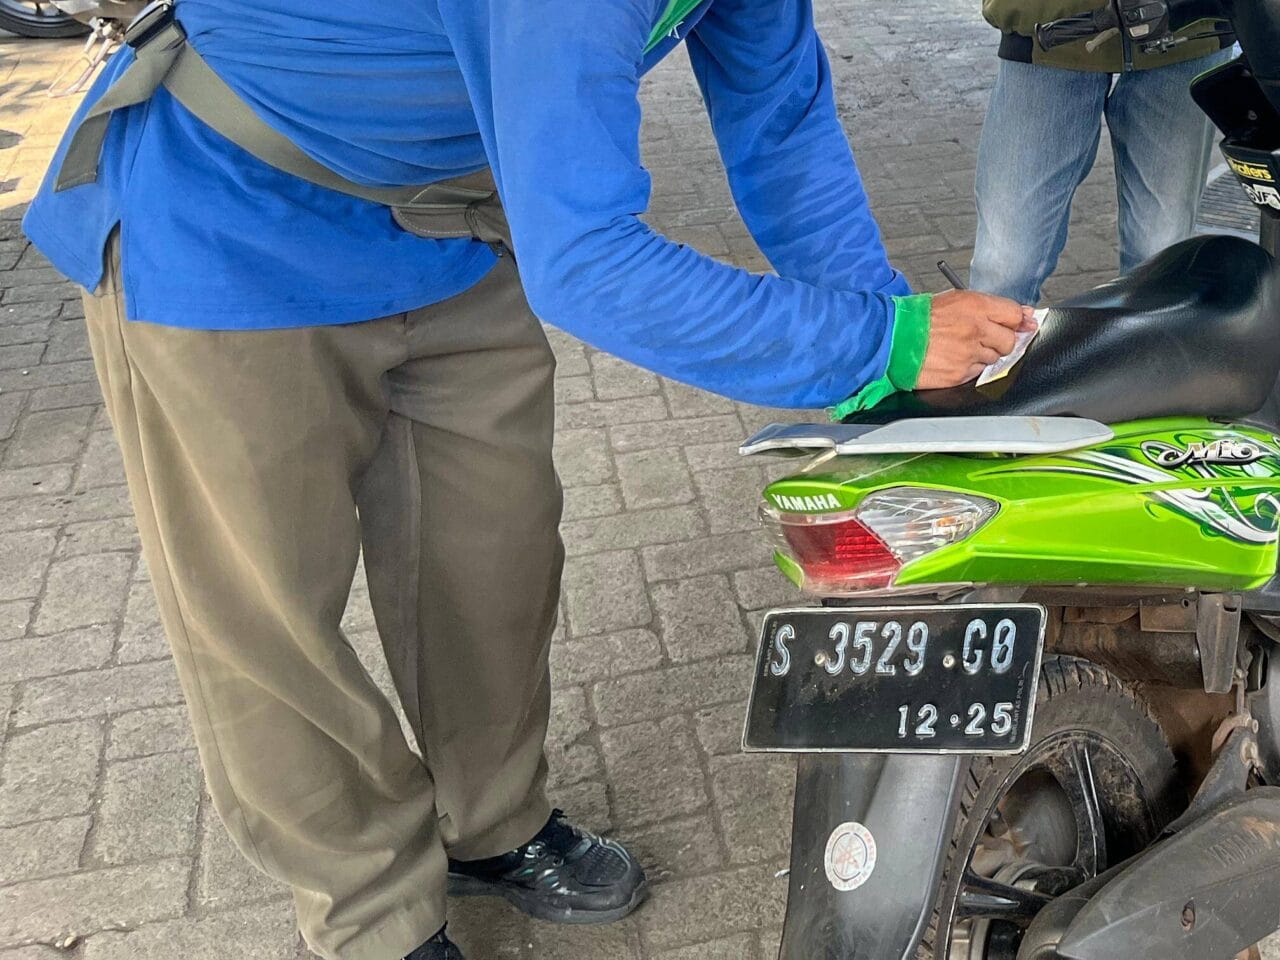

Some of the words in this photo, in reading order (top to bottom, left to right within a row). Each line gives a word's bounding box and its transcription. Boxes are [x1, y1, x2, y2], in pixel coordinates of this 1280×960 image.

[771, 493, 842, 511] YAMAHA
[770, 623, 795, 676] S
[824, 620, 929, 676] 3529
